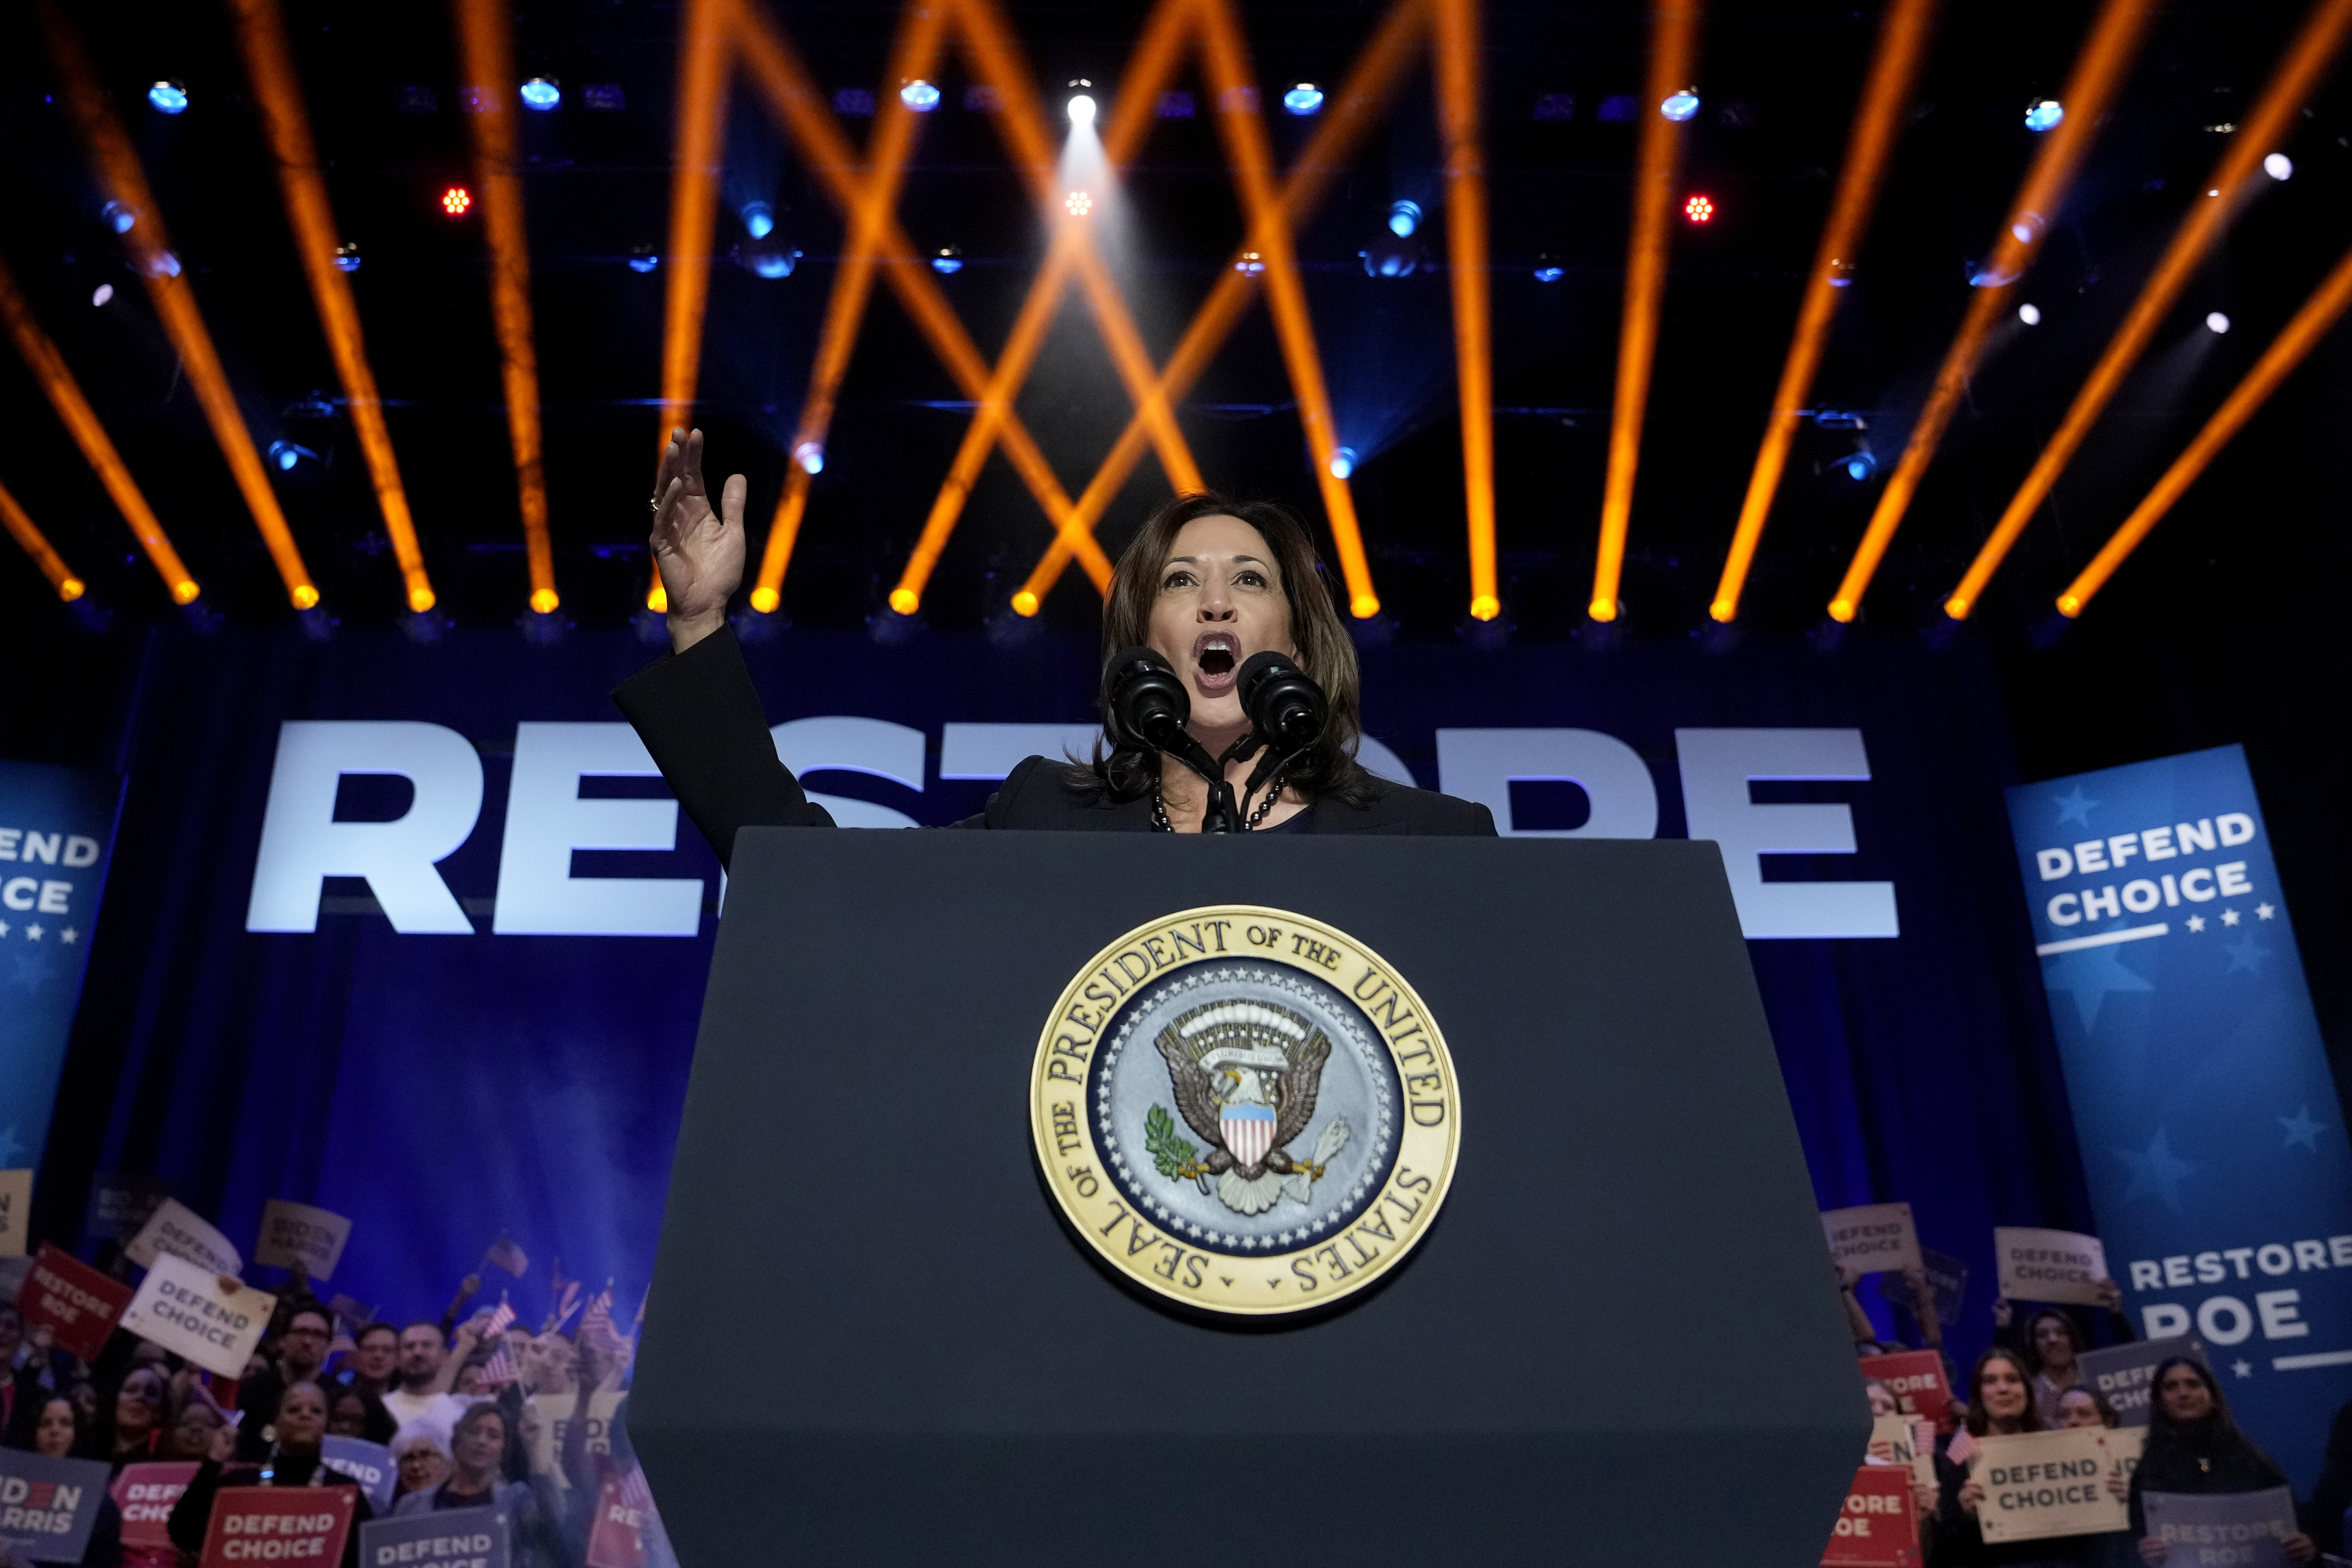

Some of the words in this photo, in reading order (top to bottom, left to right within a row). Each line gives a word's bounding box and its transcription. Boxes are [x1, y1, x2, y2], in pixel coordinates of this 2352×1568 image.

[2036, 812, 2256, 881] DEFEND
[2047, 861, 2253, 927] CHOICE
[1247, 926, 1282, 948] OF
[1292, 934, 1342, 971] THE
[1048, 920, 1231, 1085] PRESIDENT
[1353, 967, 1445, 1127] UNITED
[1052, 1101, 1082, 1156] THE
[1067, 1165, 1099, 1197] OF
[1099, 1198, 1209, 1288] SEAL
[1292, 1165, 1432, 1291] STATES
[2011, 1247, 2094, 1267] DEFEND
[2015, 1265, 2093, 1282] CHOICE
[2130, 1235, 2352, 1291] RESTORE
[152, 1301, 237, 1349] CHOICE
[159, 1280, 249, 1330] DEFEND
[1990, 1459, 2098, 1486] DEFEND
[1999, 1484, 2099, 1511] CHOICE
[224, 1513, 335, 1534] DEFEND
[223, 1537, 326, 1560] CHOICE
[377, 1534, 492, 1565] DEFEND
